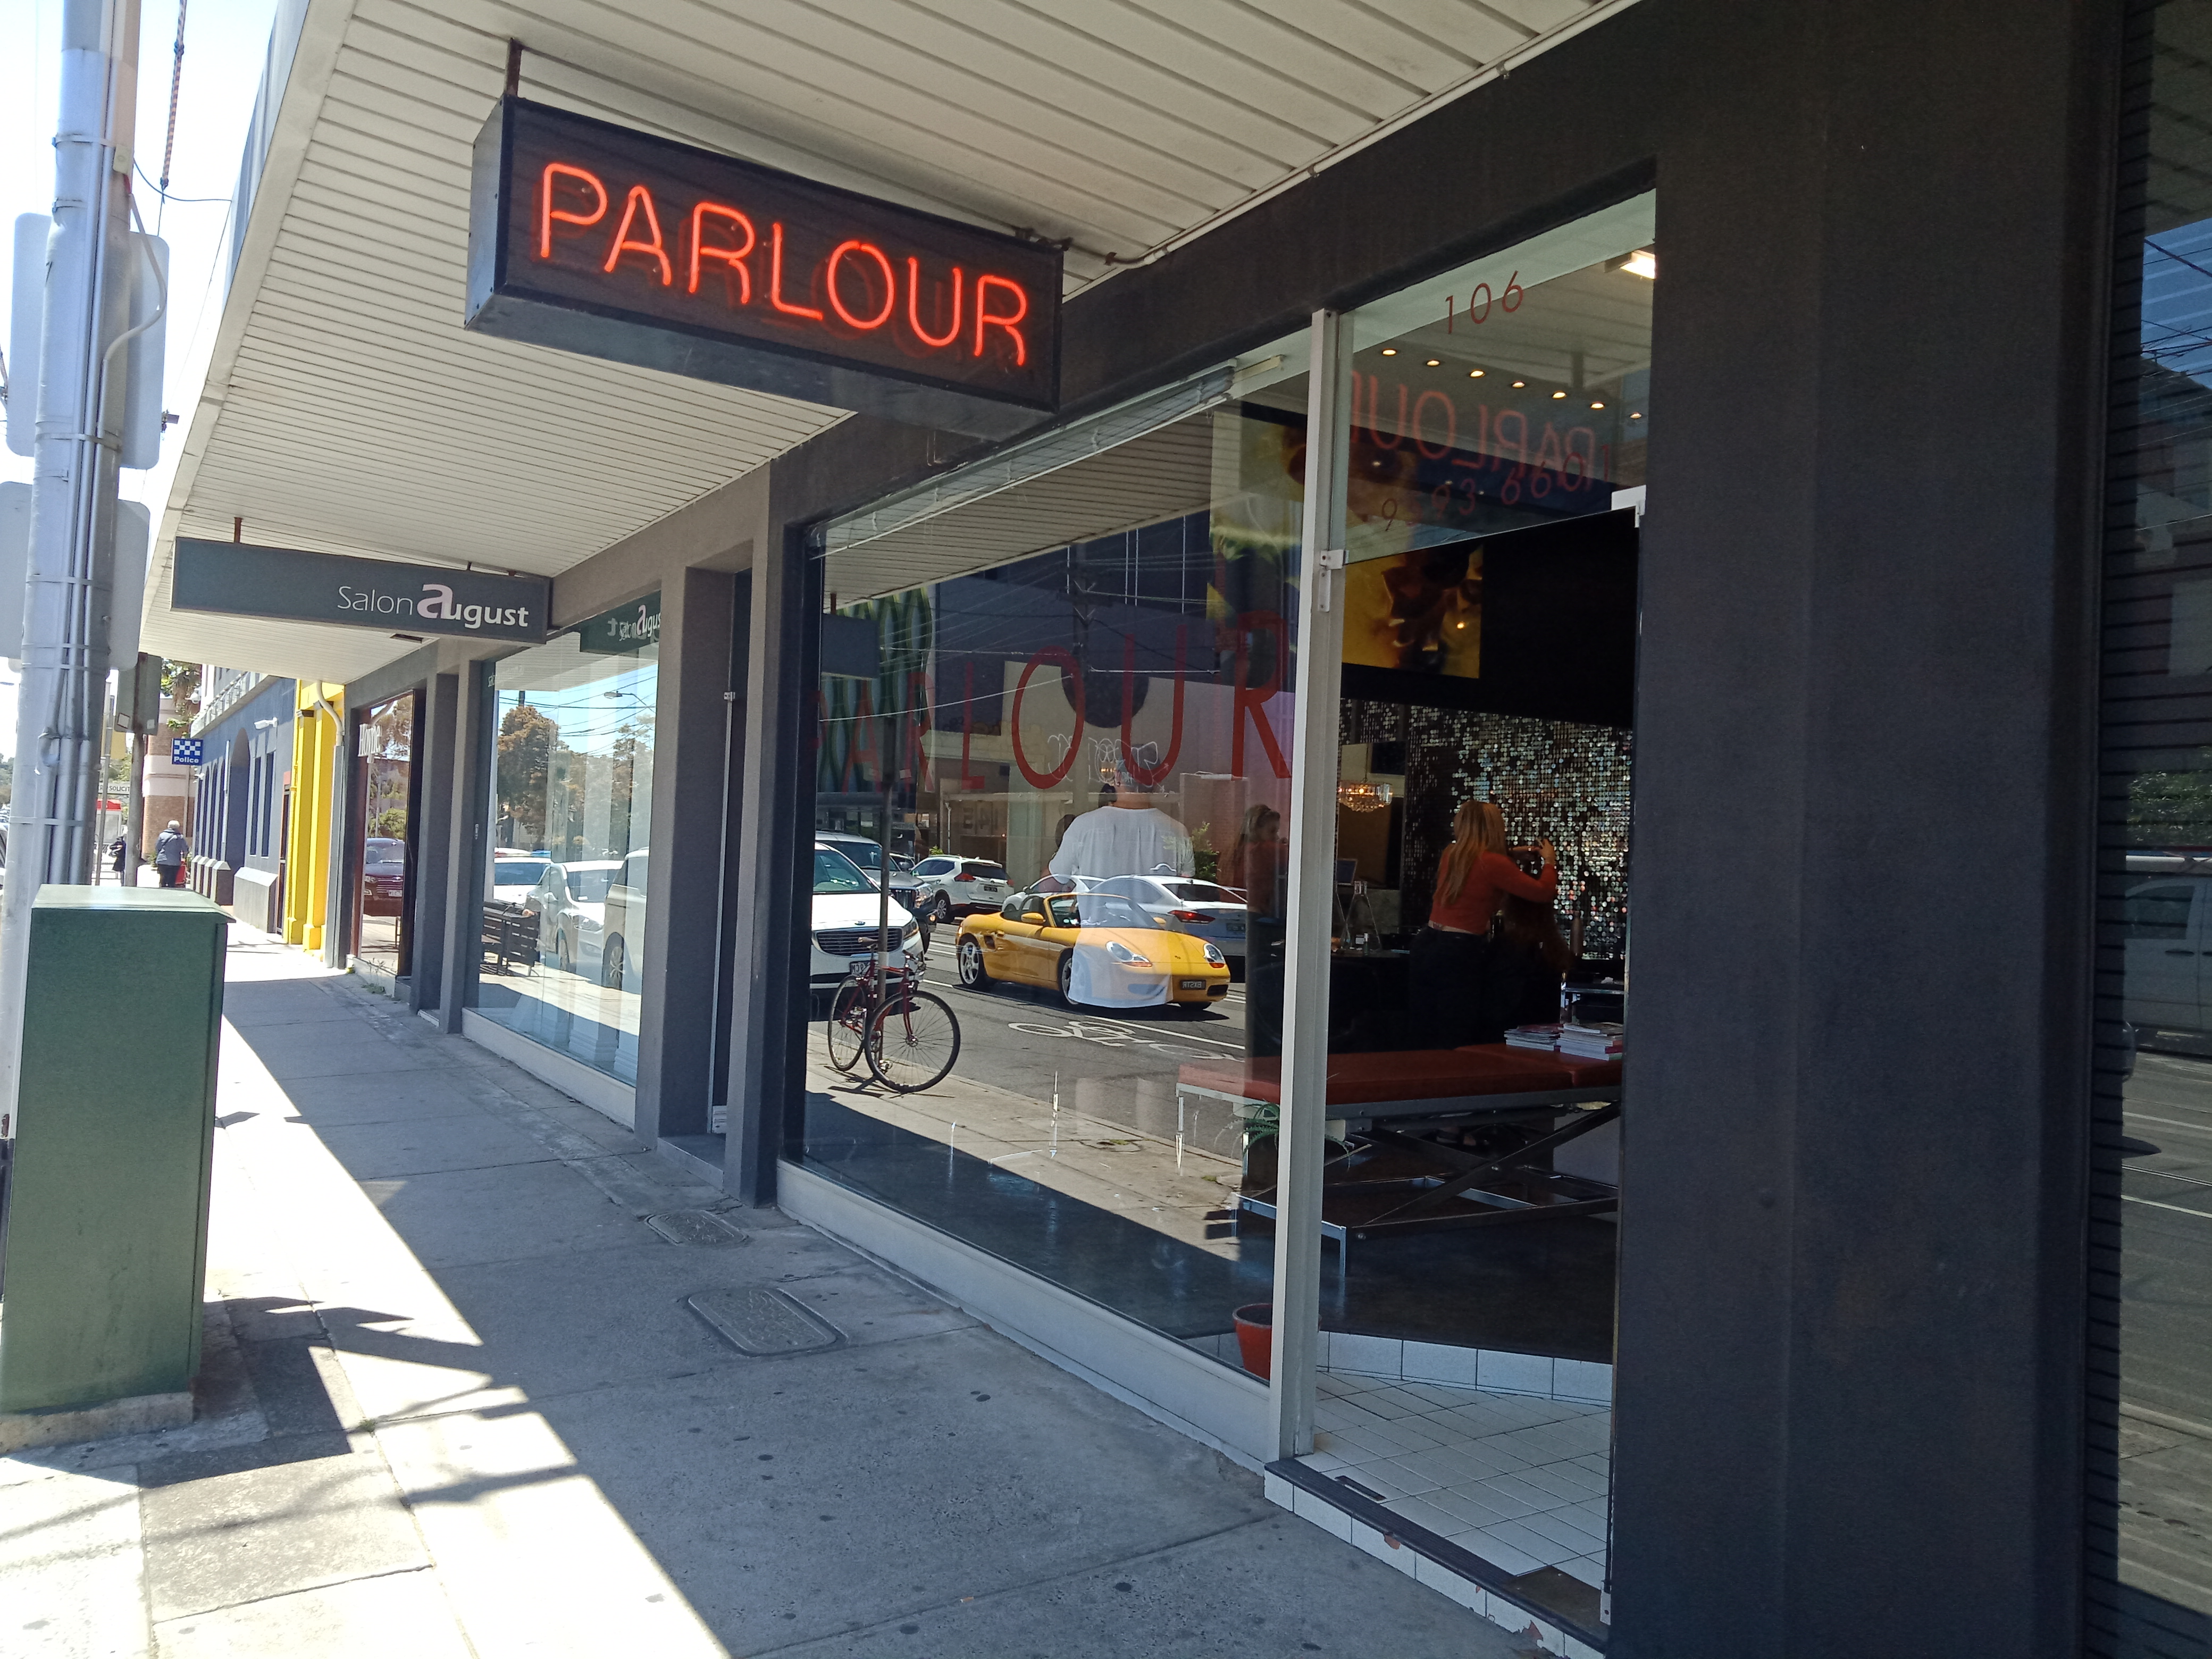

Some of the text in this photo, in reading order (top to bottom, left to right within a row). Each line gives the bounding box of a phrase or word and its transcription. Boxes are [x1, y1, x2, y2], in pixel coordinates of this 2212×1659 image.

[539, 162, 1028, 367] PARLOUR
[1445, 270, 1524, 334] 106
[1500, 444, 1610, 505] 6601
[337, 583, 529, 629] Salon august
